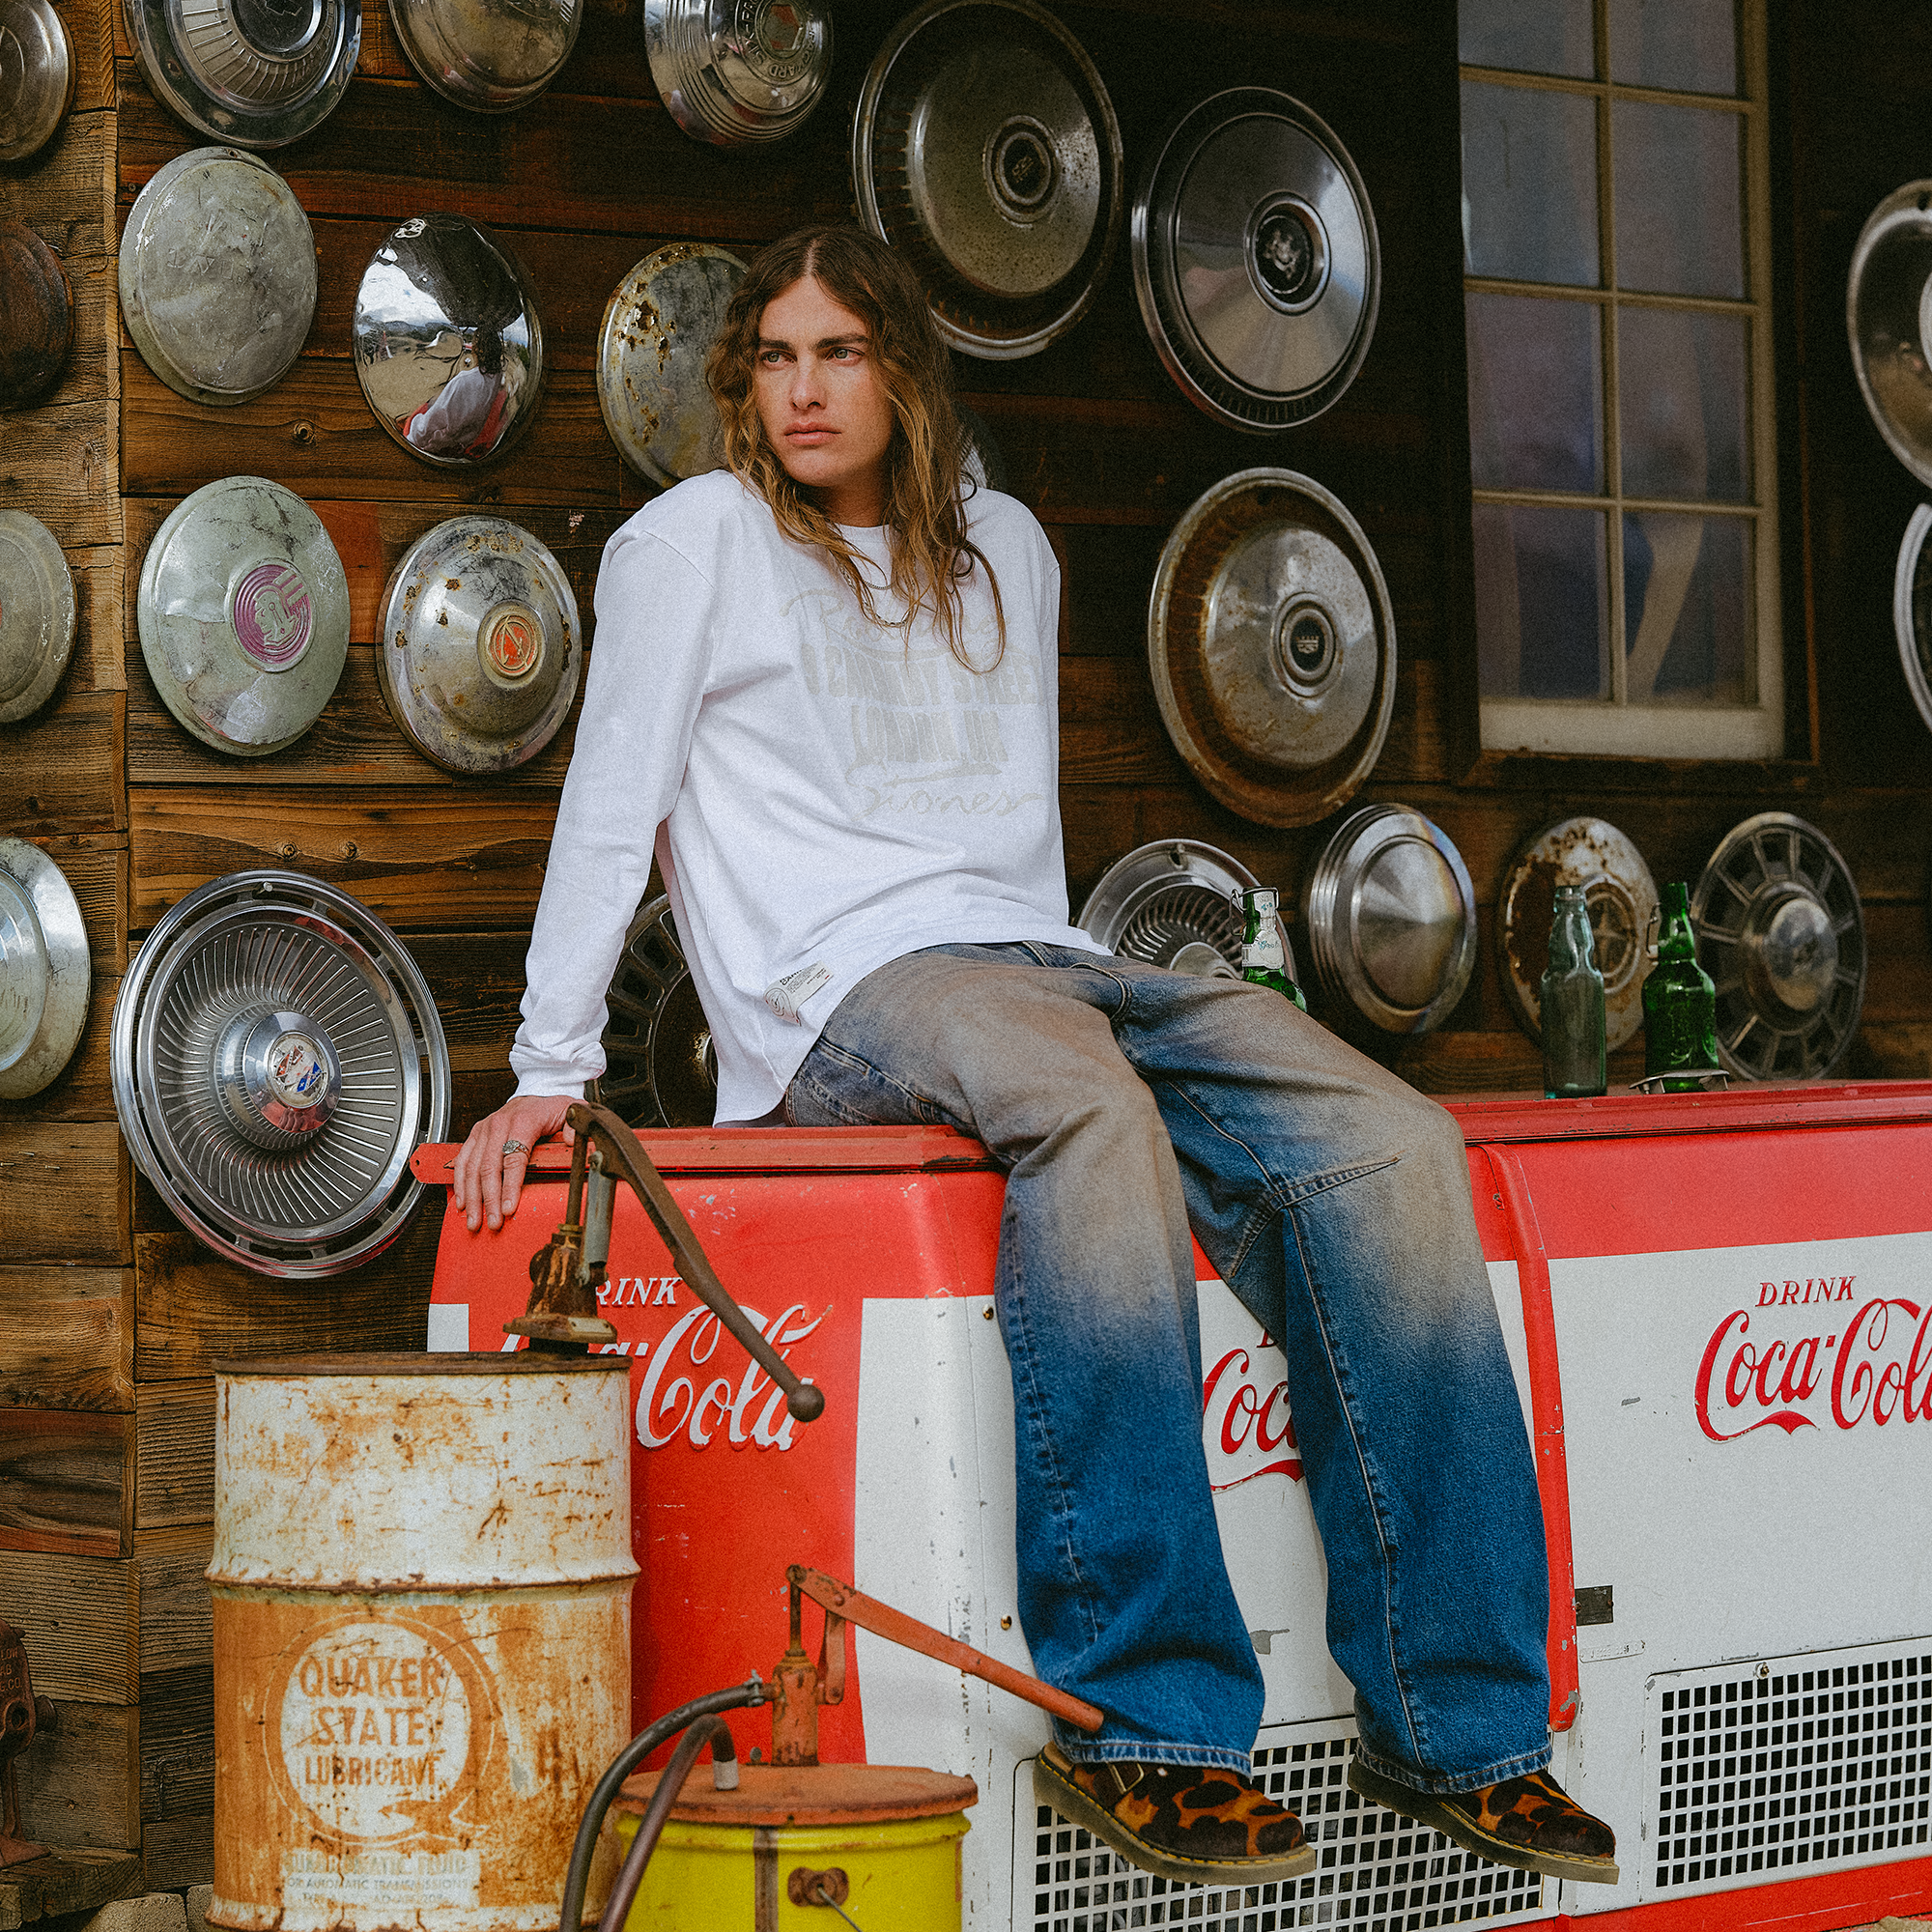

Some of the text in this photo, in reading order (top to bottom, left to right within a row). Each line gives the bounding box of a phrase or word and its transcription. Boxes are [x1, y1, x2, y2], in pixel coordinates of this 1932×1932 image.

[962, 710, 1009, 763] UK
[844, 757, 1045, 822] Stones
[596, 1277, 682, 1306] RINK
[1755, 1276, 1857, 1307] DRINK
[1694, 1298, 1932, 1444] Coca-Col
[298, 1657, 442, 1697] QUAKER
[310, 1705, 426, 1747] STATE
[304, 1754, 441, 1786] LUBRICANT
[306, 1879, 369, 1889] AUTOMATIC
